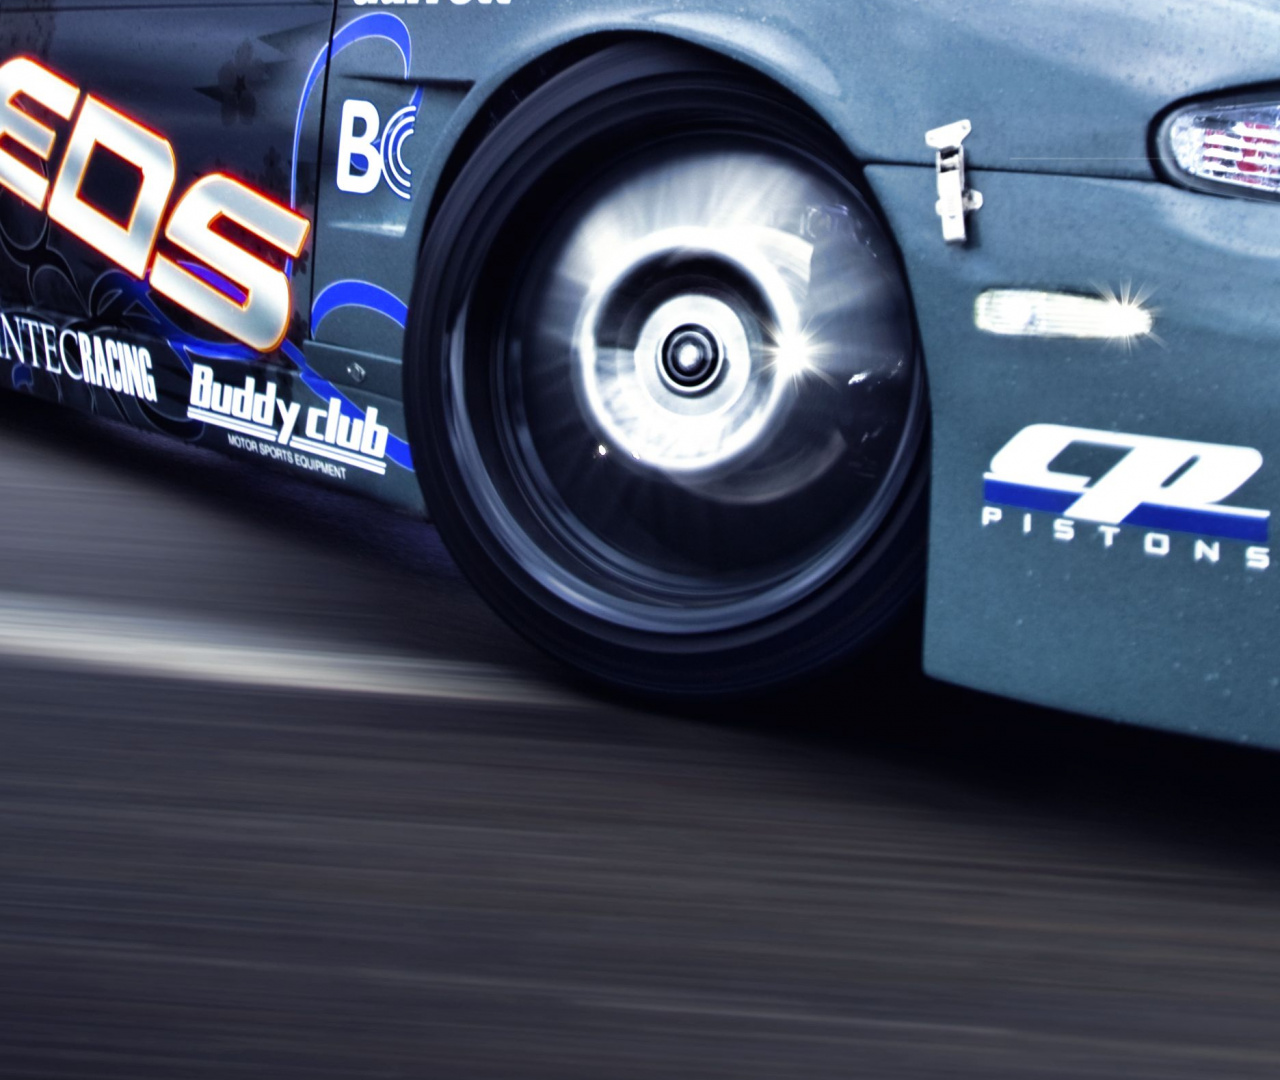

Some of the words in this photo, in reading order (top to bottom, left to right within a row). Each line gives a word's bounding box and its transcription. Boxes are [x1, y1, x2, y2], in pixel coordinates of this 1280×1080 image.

[190, 363, 301, 445] Buddy
[305, 396, 389, 459] club
[227, 433, 259, 455] MOTOR
[259, 440, 294, 465] SPORTS
[295, 453, 347, 481] EQUIPMENT
[989, 423, 1264, 525] CP
[981, 505, 1271, 570] PISTONS
